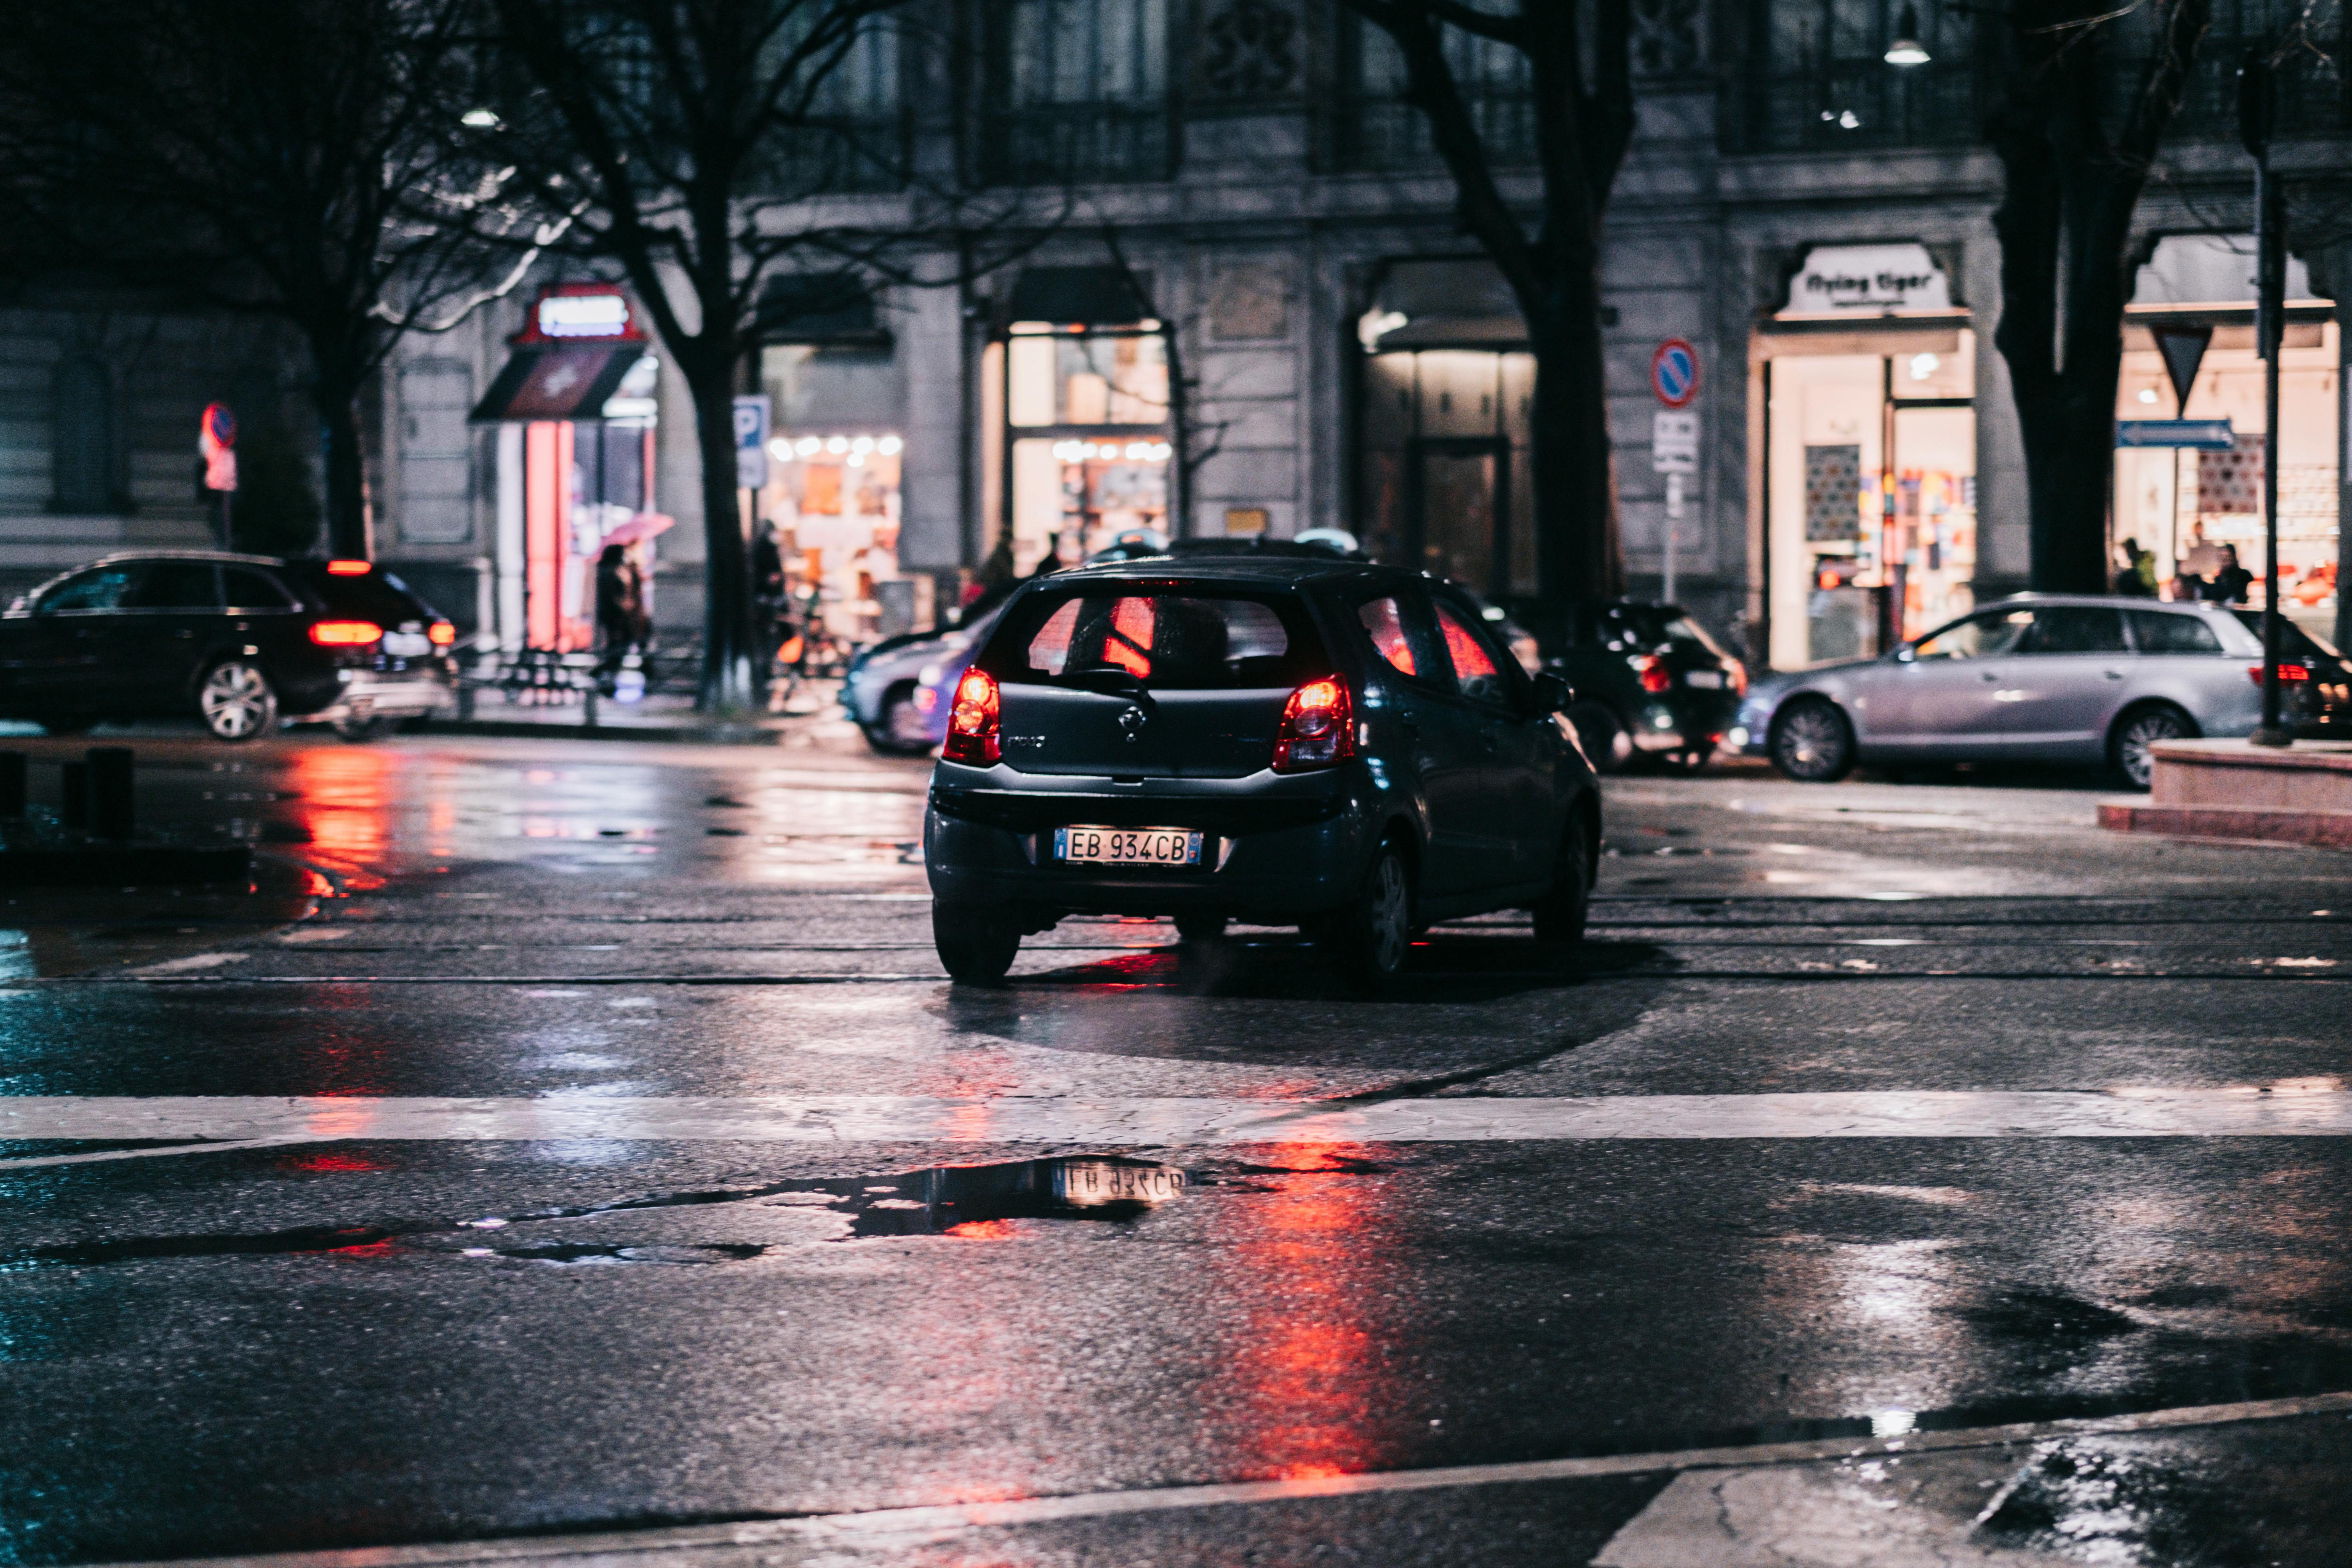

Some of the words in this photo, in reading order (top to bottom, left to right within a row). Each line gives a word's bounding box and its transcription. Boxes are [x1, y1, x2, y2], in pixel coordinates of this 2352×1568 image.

[734, 408, 758, 447] P
[1071, 833, 1100, 858] EB
[1110, 834, 1185, 861] 934CB
